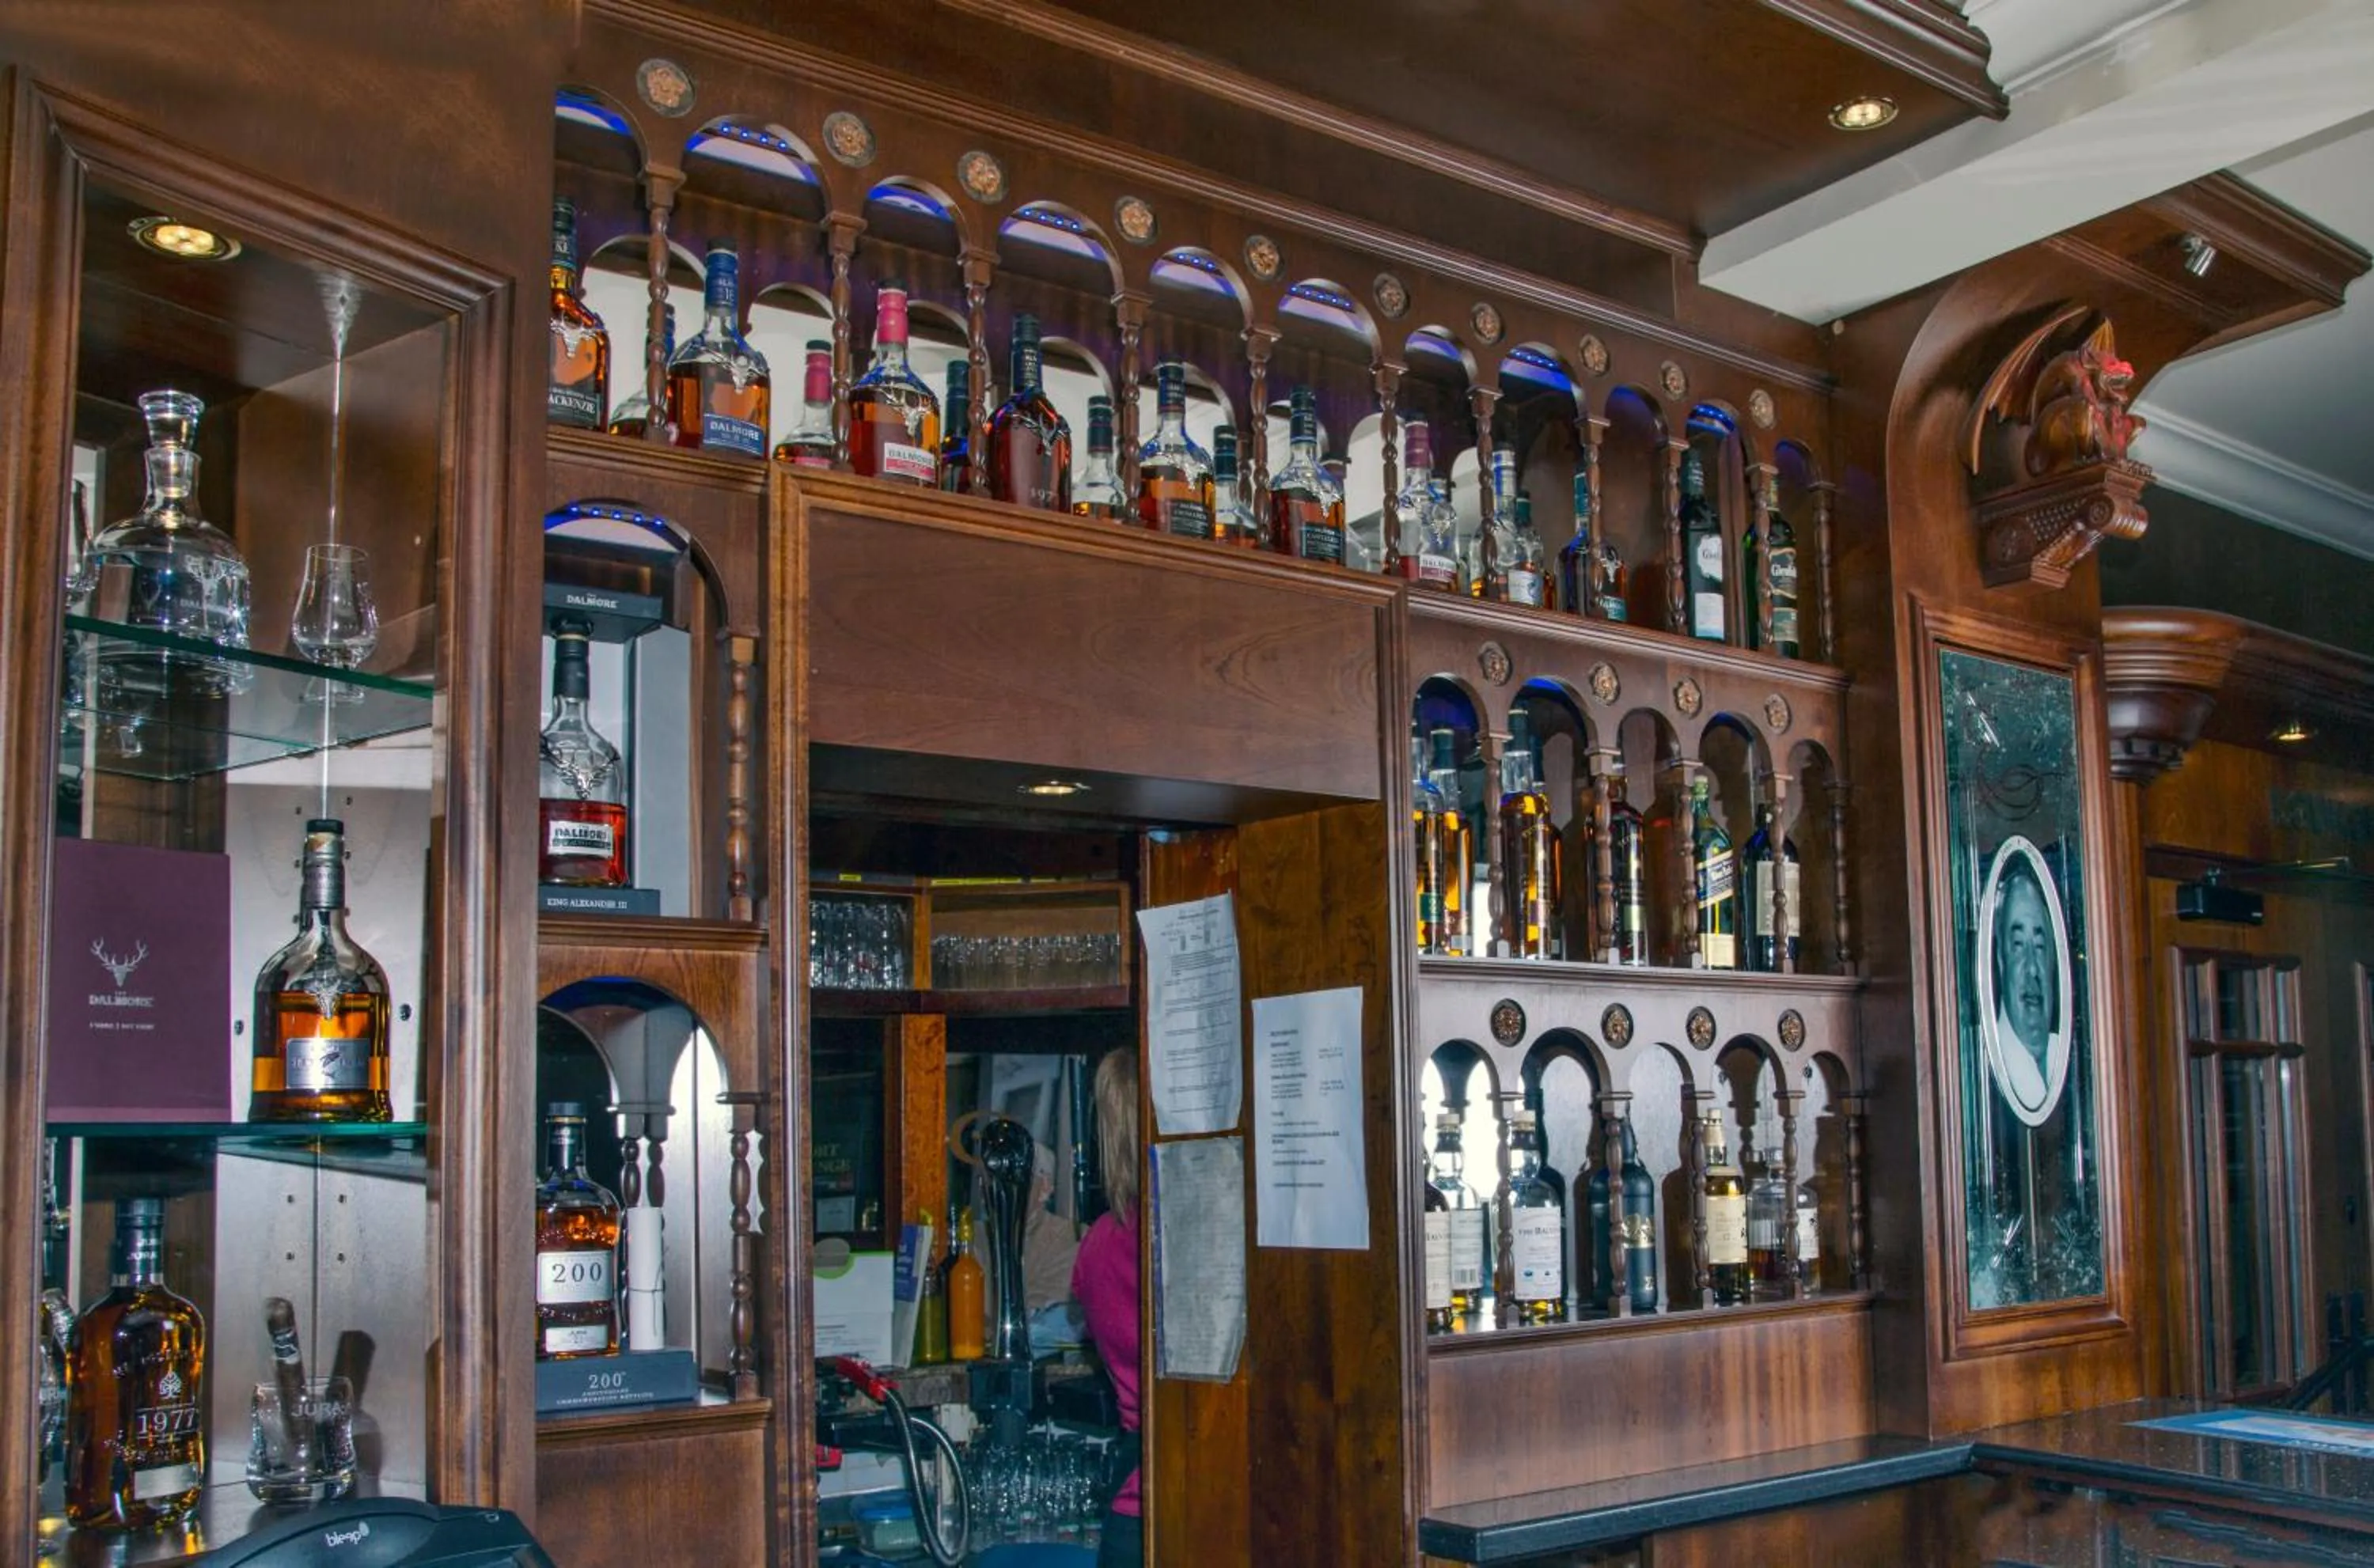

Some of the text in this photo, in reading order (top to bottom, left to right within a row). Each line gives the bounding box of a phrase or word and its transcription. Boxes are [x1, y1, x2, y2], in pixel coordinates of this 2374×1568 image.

[547, 392, 596, 414] ACKENZIE
[710, 421, 760, 441] DALMORE
[567, 595, 617, 608] DALMORE
[547, 898, 569, 907] KING
[89, 994, 154, 1008] DALMORE
[552, 1262, 602, 1283] 200
[290, 1401, 347, 1420] JURA
[138, 1408, 196, 1435] 1977
